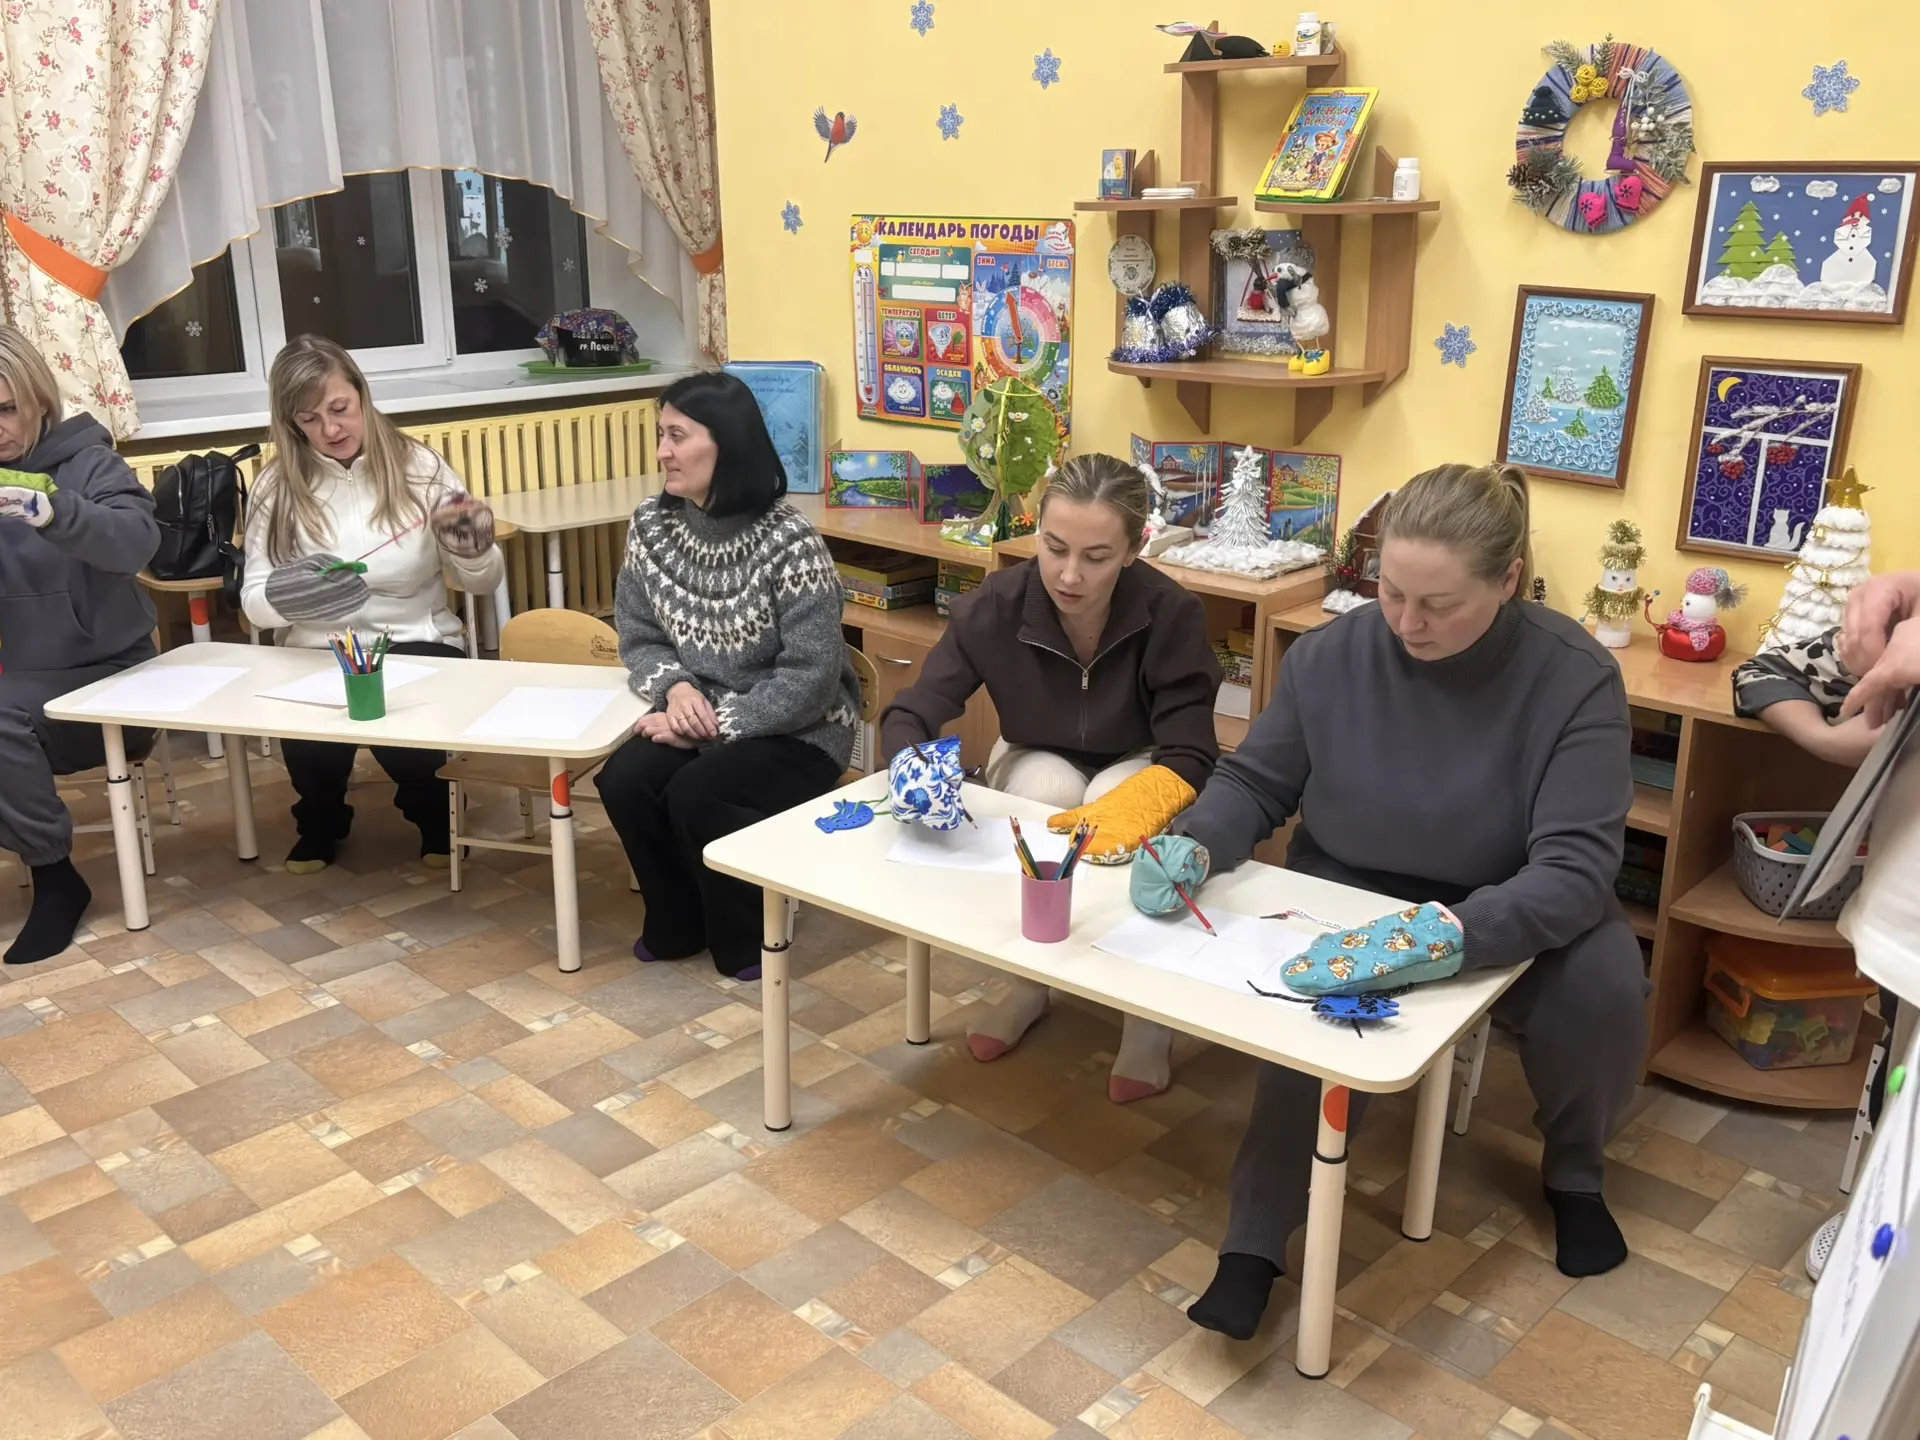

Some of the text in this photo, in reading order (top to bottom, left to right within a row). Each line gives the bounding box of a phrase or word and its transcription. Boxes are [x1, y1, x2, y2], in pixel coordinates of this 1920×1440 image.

[879, 221, 966, 239] КАЛЕНДАРЬ
[971, 223, 1040, 243] ПОГОДЫ
[909, 247, 940, 256] СЕГОДНЯ
[977, 256, 996, 266] ЗИМА
[1047, 259, 1069, 269] ВЕСНА
[881, 307, 921, 317] ТЕМПЕРАТУРА
[937, 311, 956, 320] ВЕТЕР
[884, 363, 922, 375] ОБЛАЧНОСТЬ
[936, 368, 962, 379] ОСАДКИ
